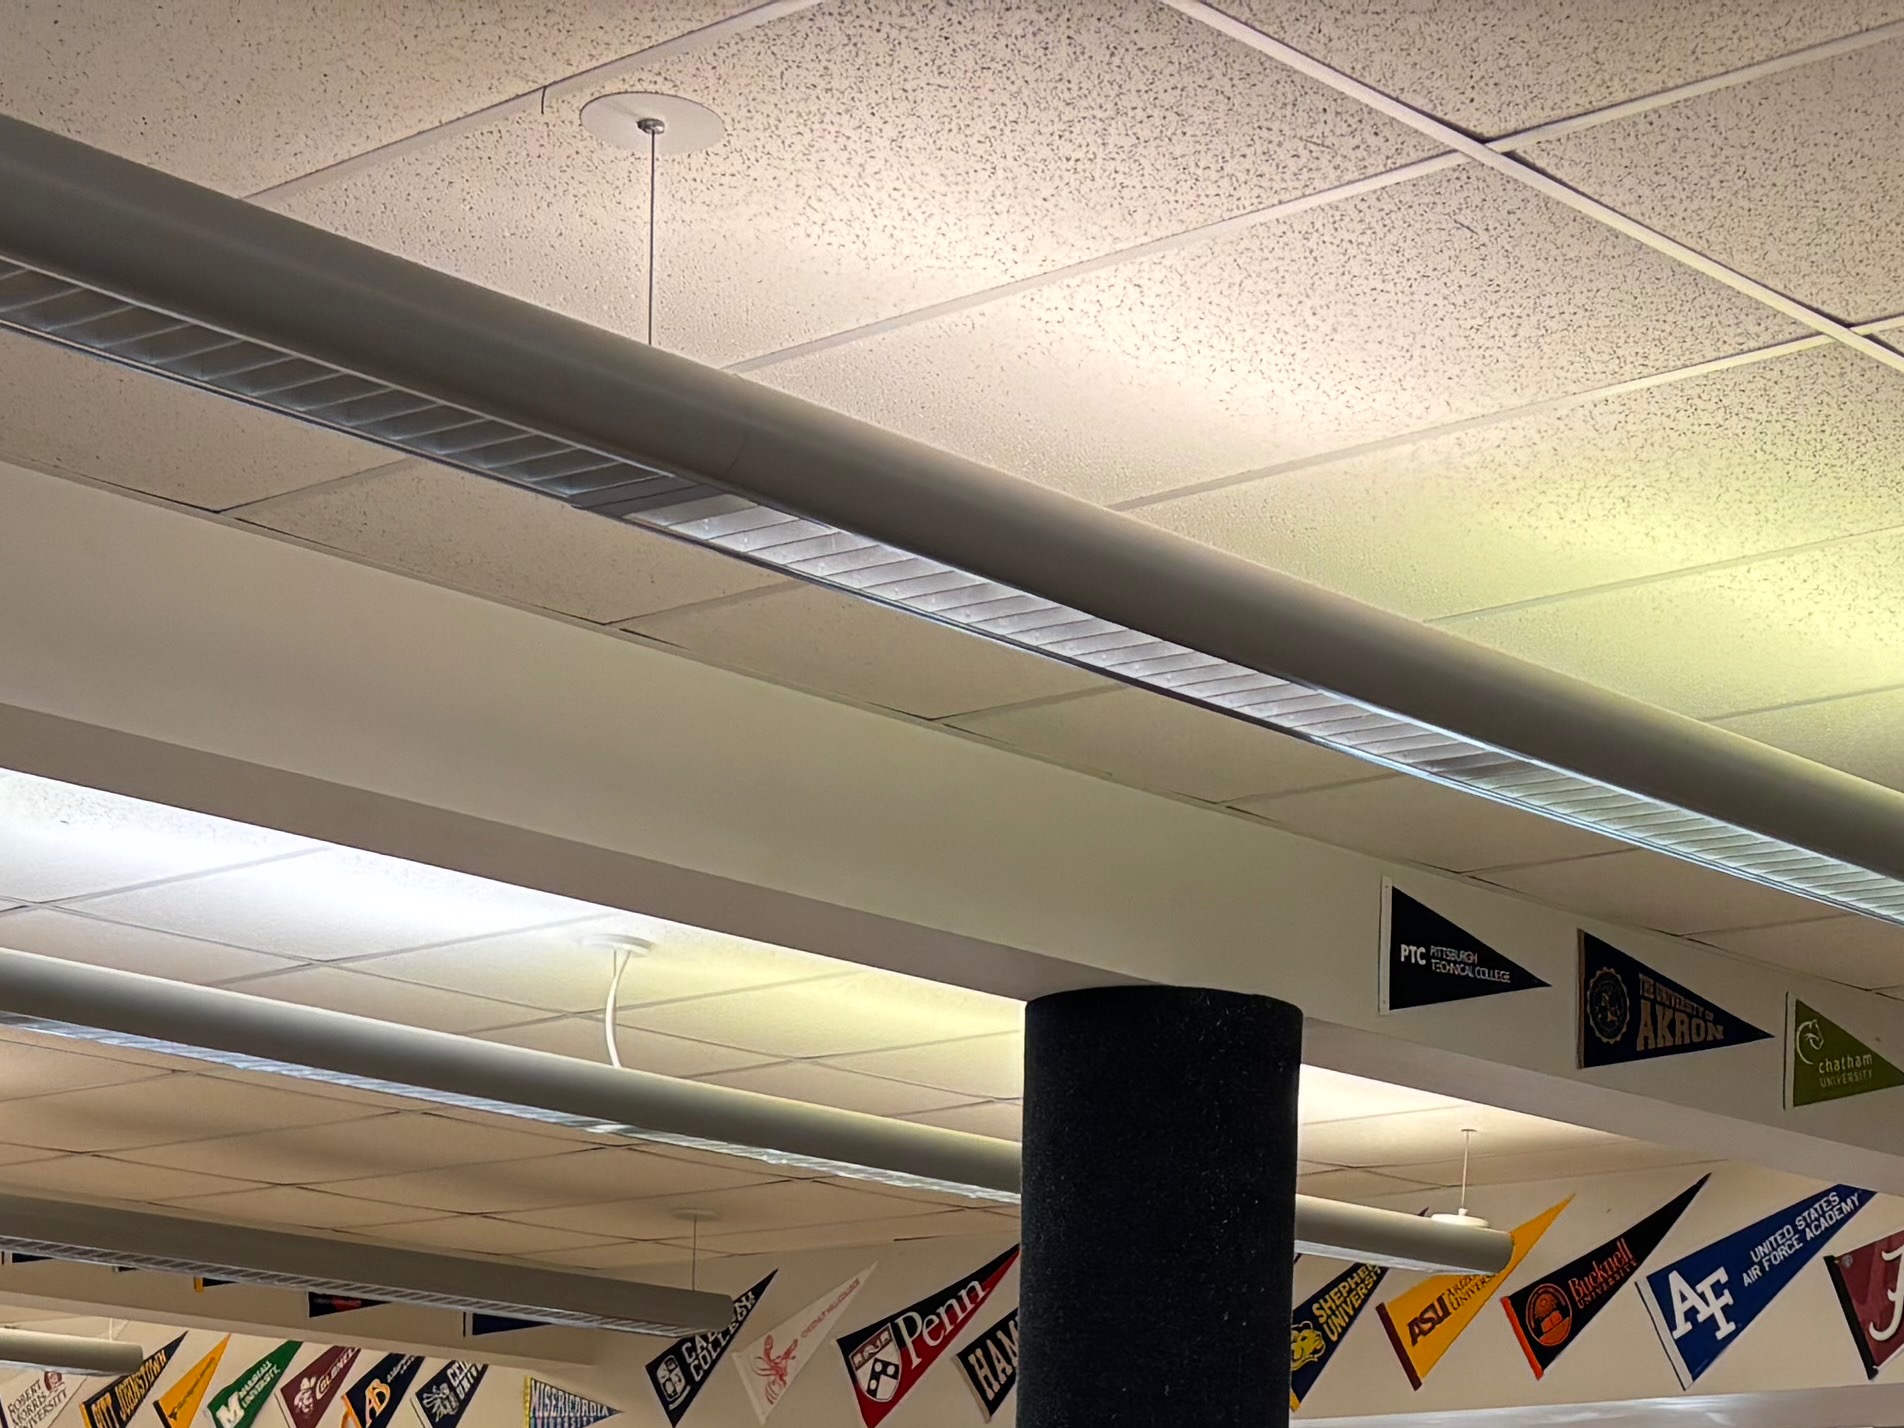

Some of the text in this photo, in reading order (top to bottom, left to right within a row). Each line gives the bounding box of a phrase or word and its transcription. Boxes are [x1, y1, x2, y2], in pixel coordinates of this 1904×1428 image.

[1400, 944, 1427, 965] PTC
[1475, 966, 1511, 983] COLLEGE
[1636, 1000, 1724, 1051] AKRON
[1819, 1054, 1873, 1074] chatham
[1820, 1069, 1872, 1088] UNIVERSITY
[1742, 1193, 1861, 1287] AIR FORCE ACADEMY
[1750, 1192, 1840, 1263] UNITED STATES
[1312, 1263, 1380, 1324] SHEPHE
[1448, 1275, 1496, 1310] UNIVERS
[1568, 1238, 1633, 1300] Bucknell
[1576, 1260, 1639, 1309] UNIVERSITY
[894, 1280, 990, 1370] Penn
[1407, 1295, 1451, 1347] ASU
[1668, 1266, 1736, 1340] AF
[8, 1379, 42, 1415] ROBERT
[10, 1391, 47, 1425] MORRIS
[530, 1380, 609, 1417] MISERICORDIA
